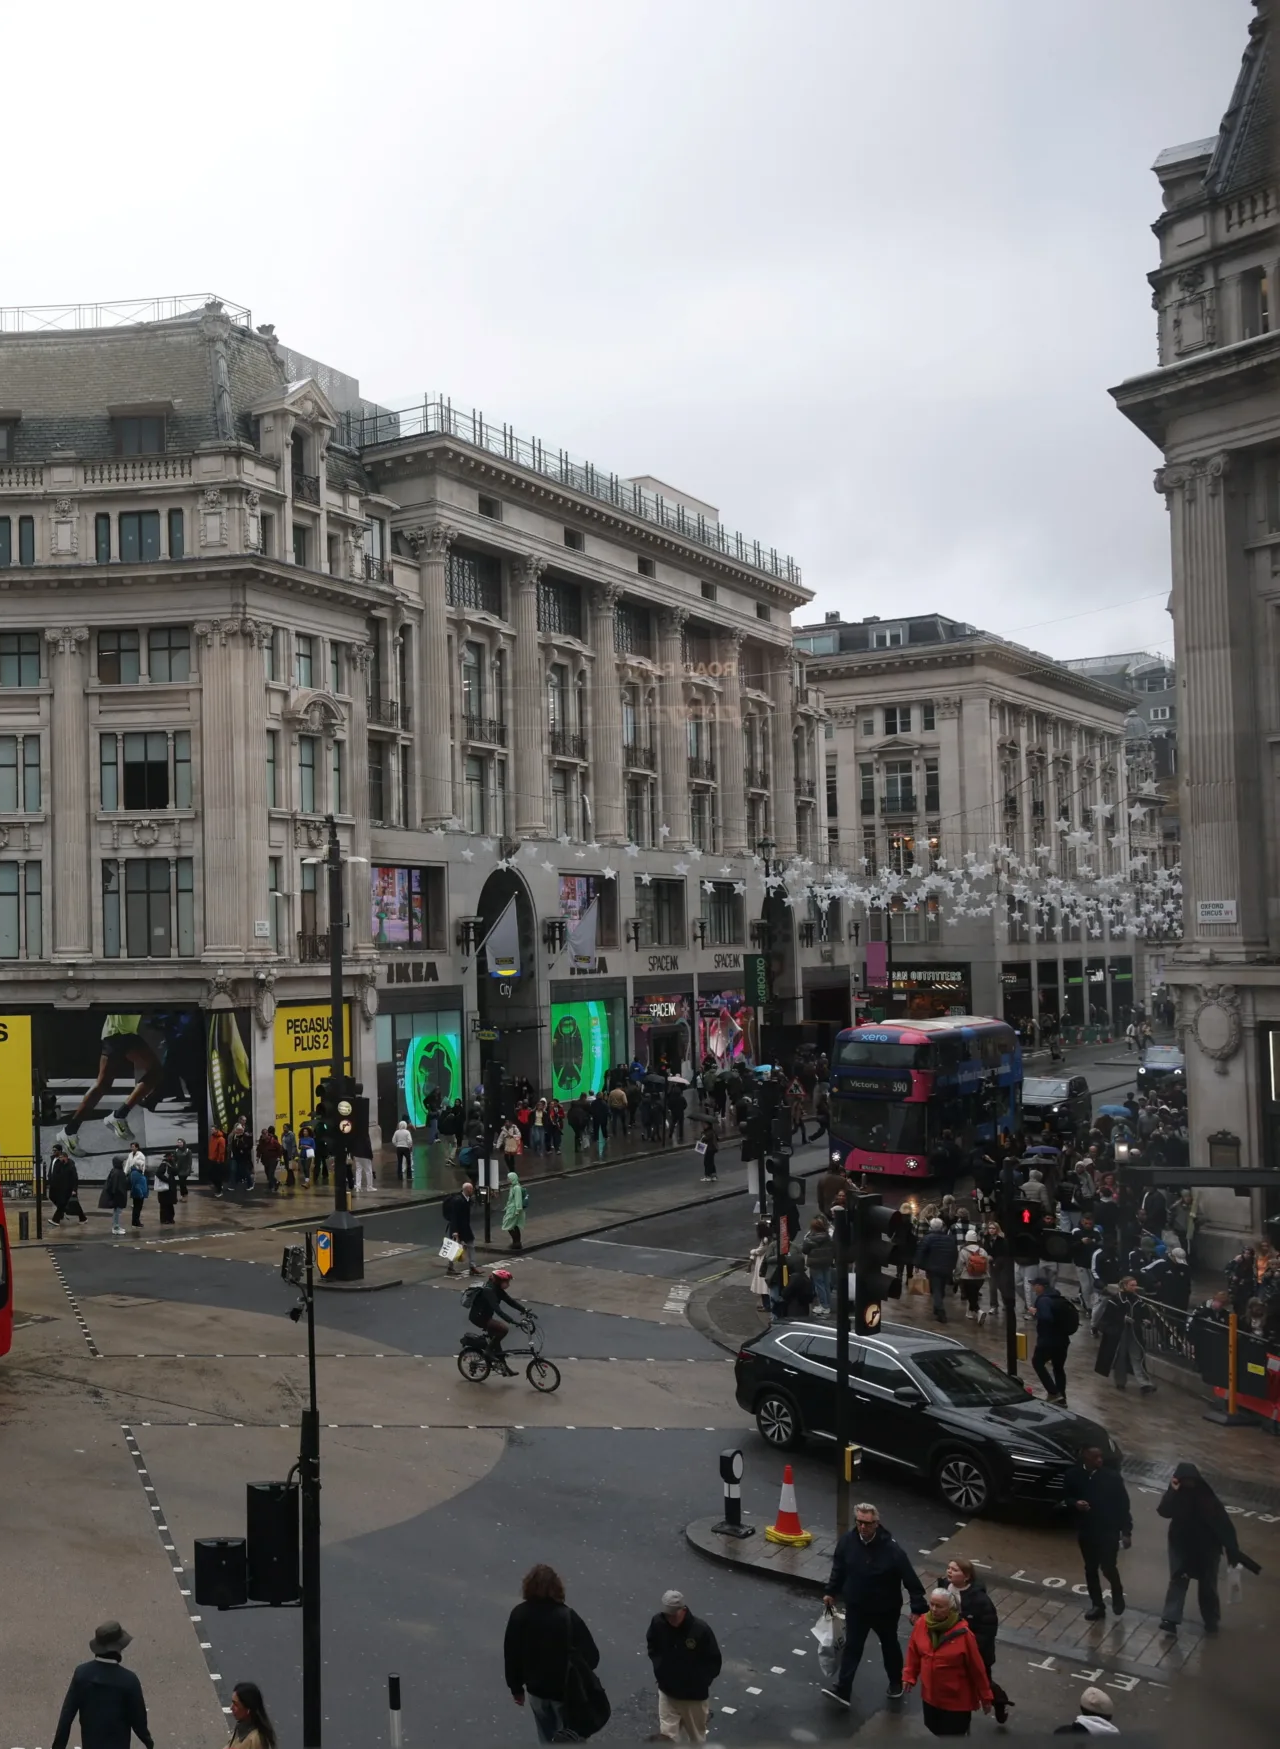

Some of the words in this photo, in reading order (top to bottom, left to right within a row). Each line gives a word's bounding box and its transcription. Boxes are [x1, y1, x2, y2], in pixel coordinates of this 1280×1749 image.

[387, 961, 439, 983] IKEA
[757, 957, 766, 998] OXFORD
[886, 971, 908, 980] BAN
[910, 971, 962, 981] OUTFITTERS
[500, 983, 513, 998] City
[294, 1034, 321, 1051] PLUS
[322, 1034, 329, 1049] 2
[861, 1033, 888, 1041] xero
[850, 1081, 879, 1089] Victoria
[892, 1082, 907, 1092] 390
